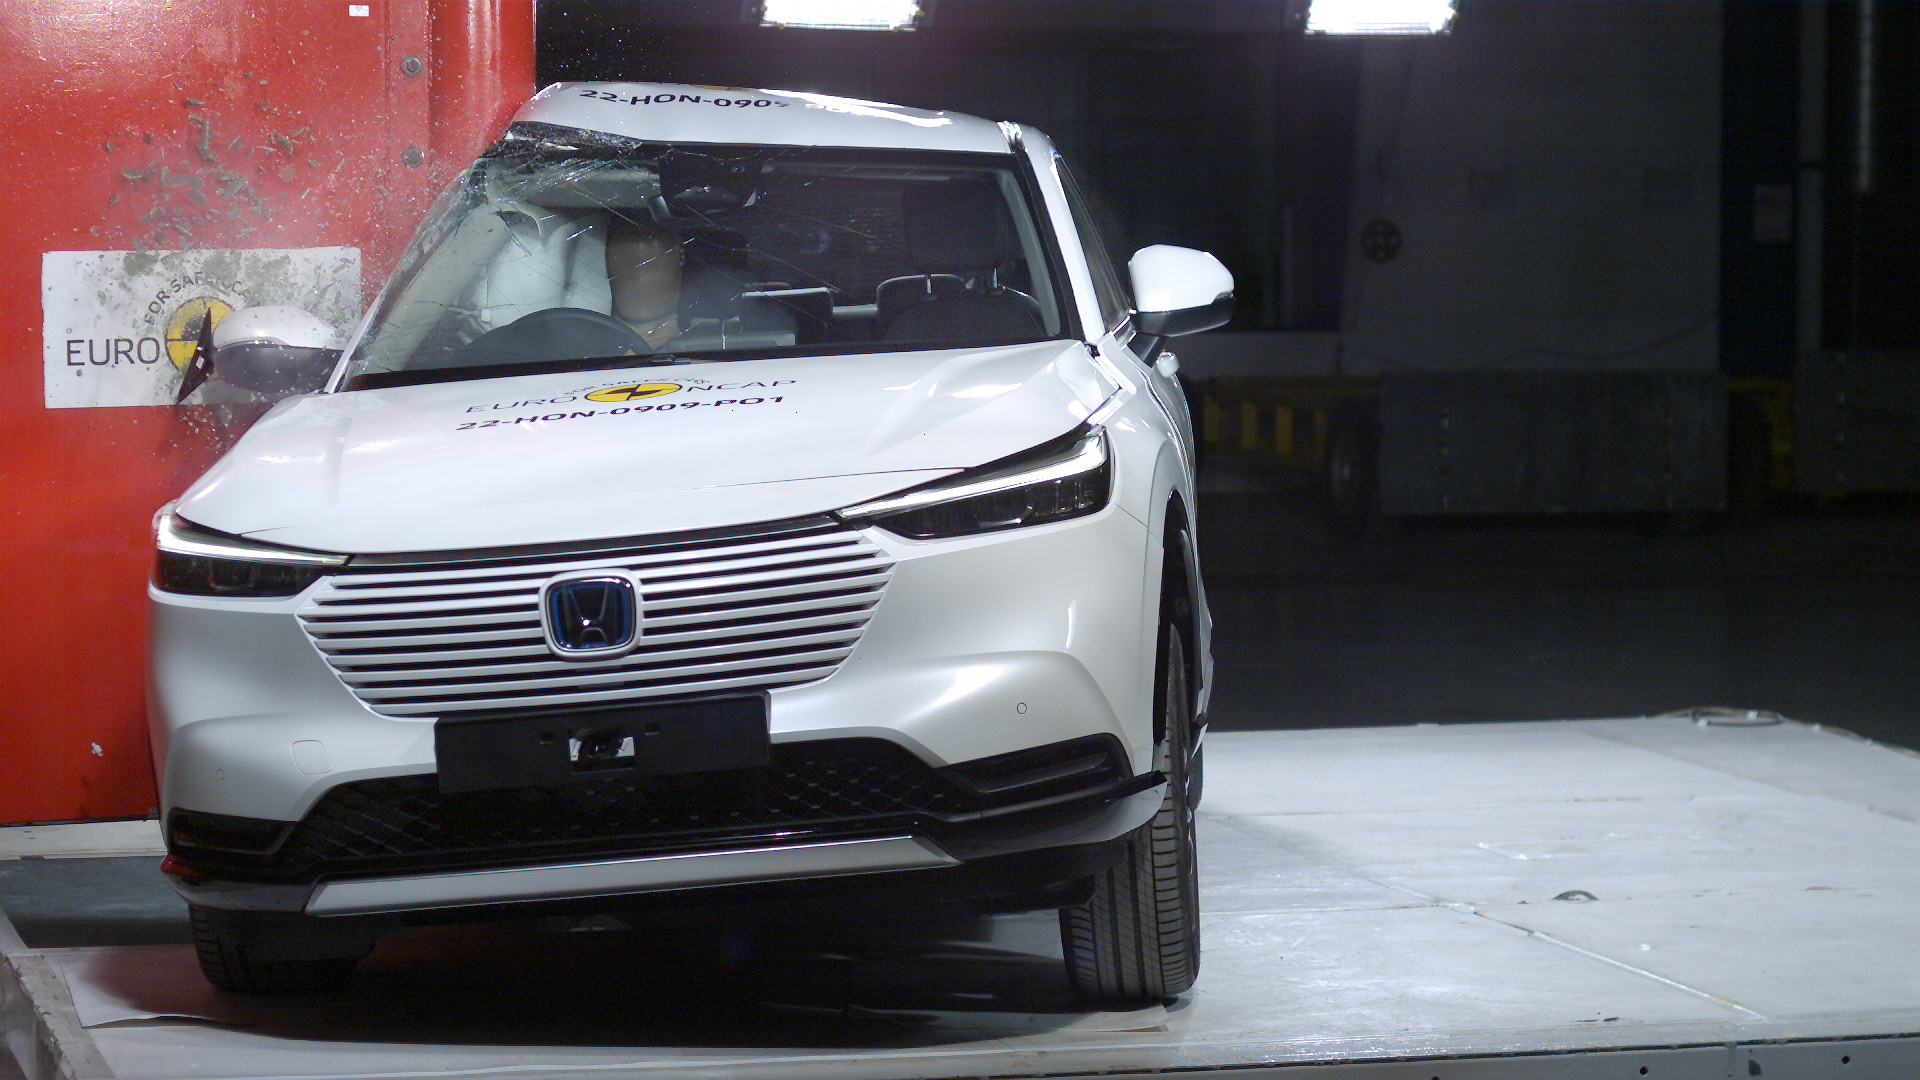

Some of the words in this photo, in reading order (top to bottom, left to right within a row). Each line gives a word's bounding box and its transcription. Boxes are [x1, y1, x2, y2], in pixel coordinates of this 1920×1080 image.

[66, 336, 161, 367] EURO
[455, 395, 784, 431] 22-HON-0909-P01
[465, 395, 578, 414] EURO
[686, 379, 797, 393] NCAP
